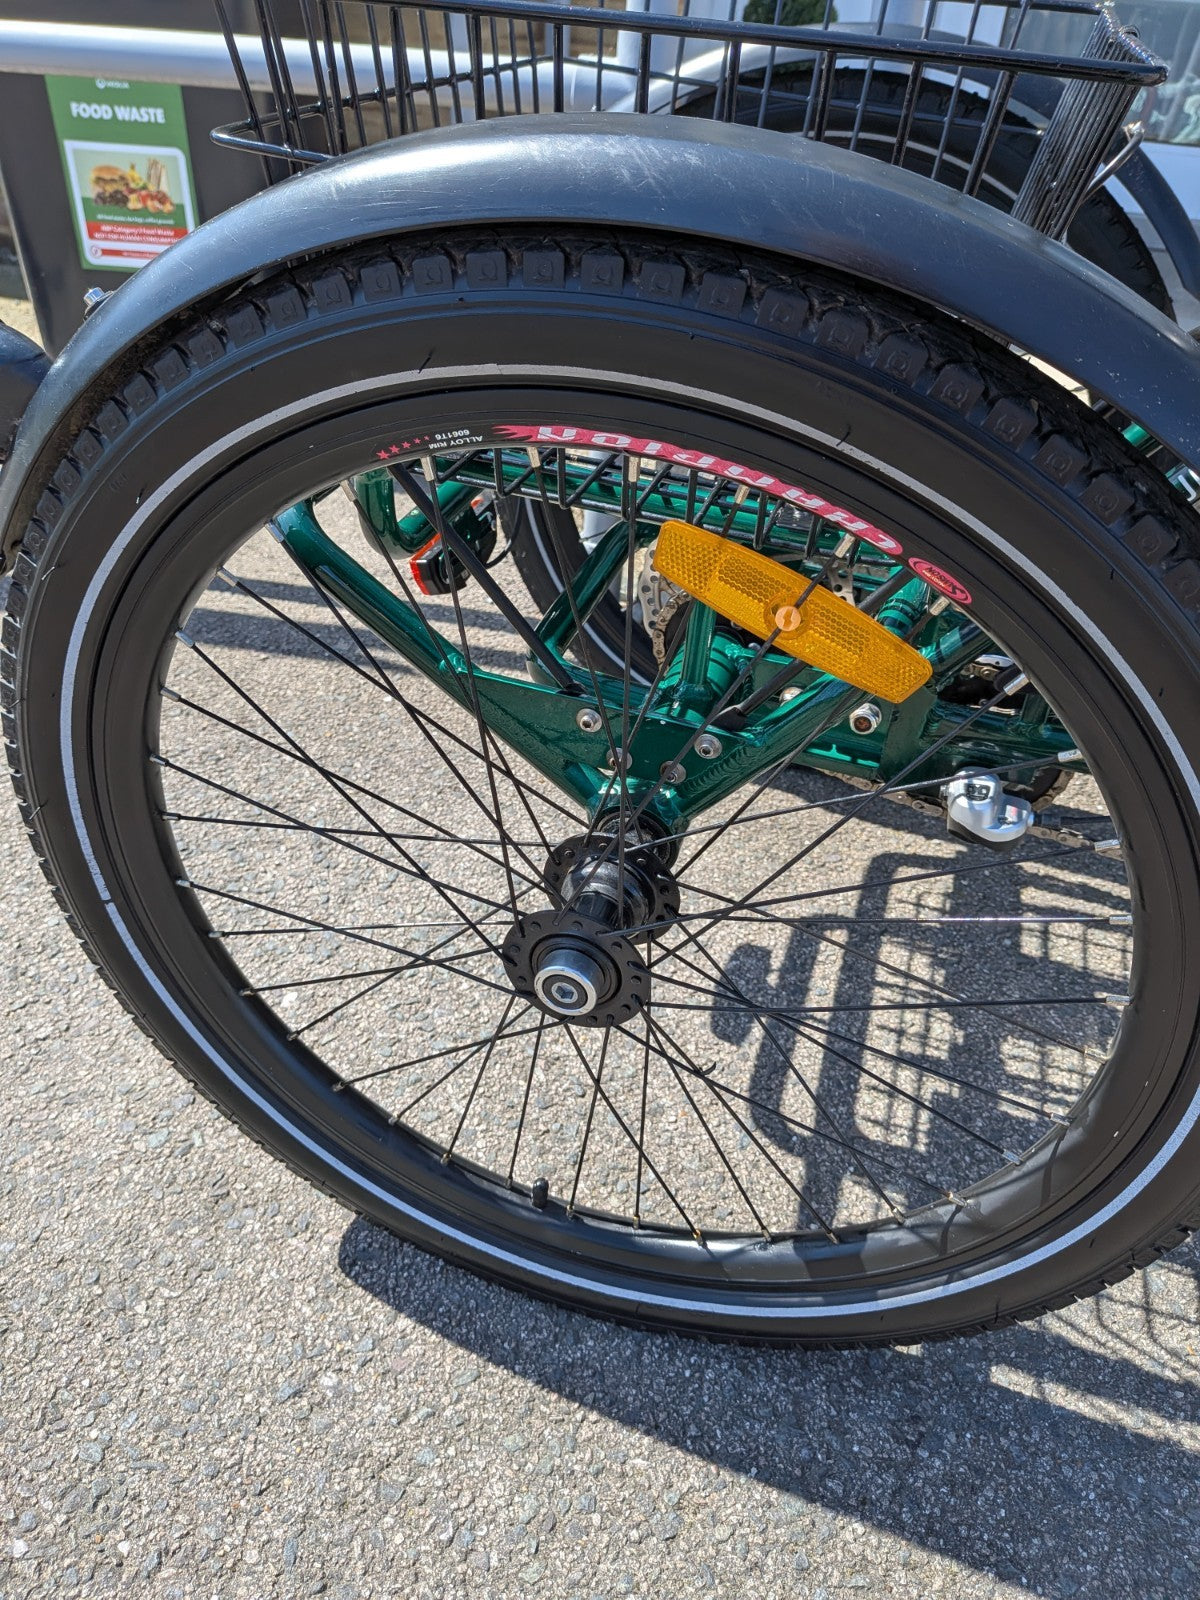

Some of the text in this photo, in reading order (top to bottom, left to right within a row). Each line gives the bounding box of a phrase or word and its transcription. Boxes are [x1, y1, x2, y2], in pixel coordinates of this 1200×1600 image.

[69, 101, 166, 124] FOOD WASTE
[428, 435, 484, 450] ALLOY RIM
[435, 429, 470, 441] 6061T6
